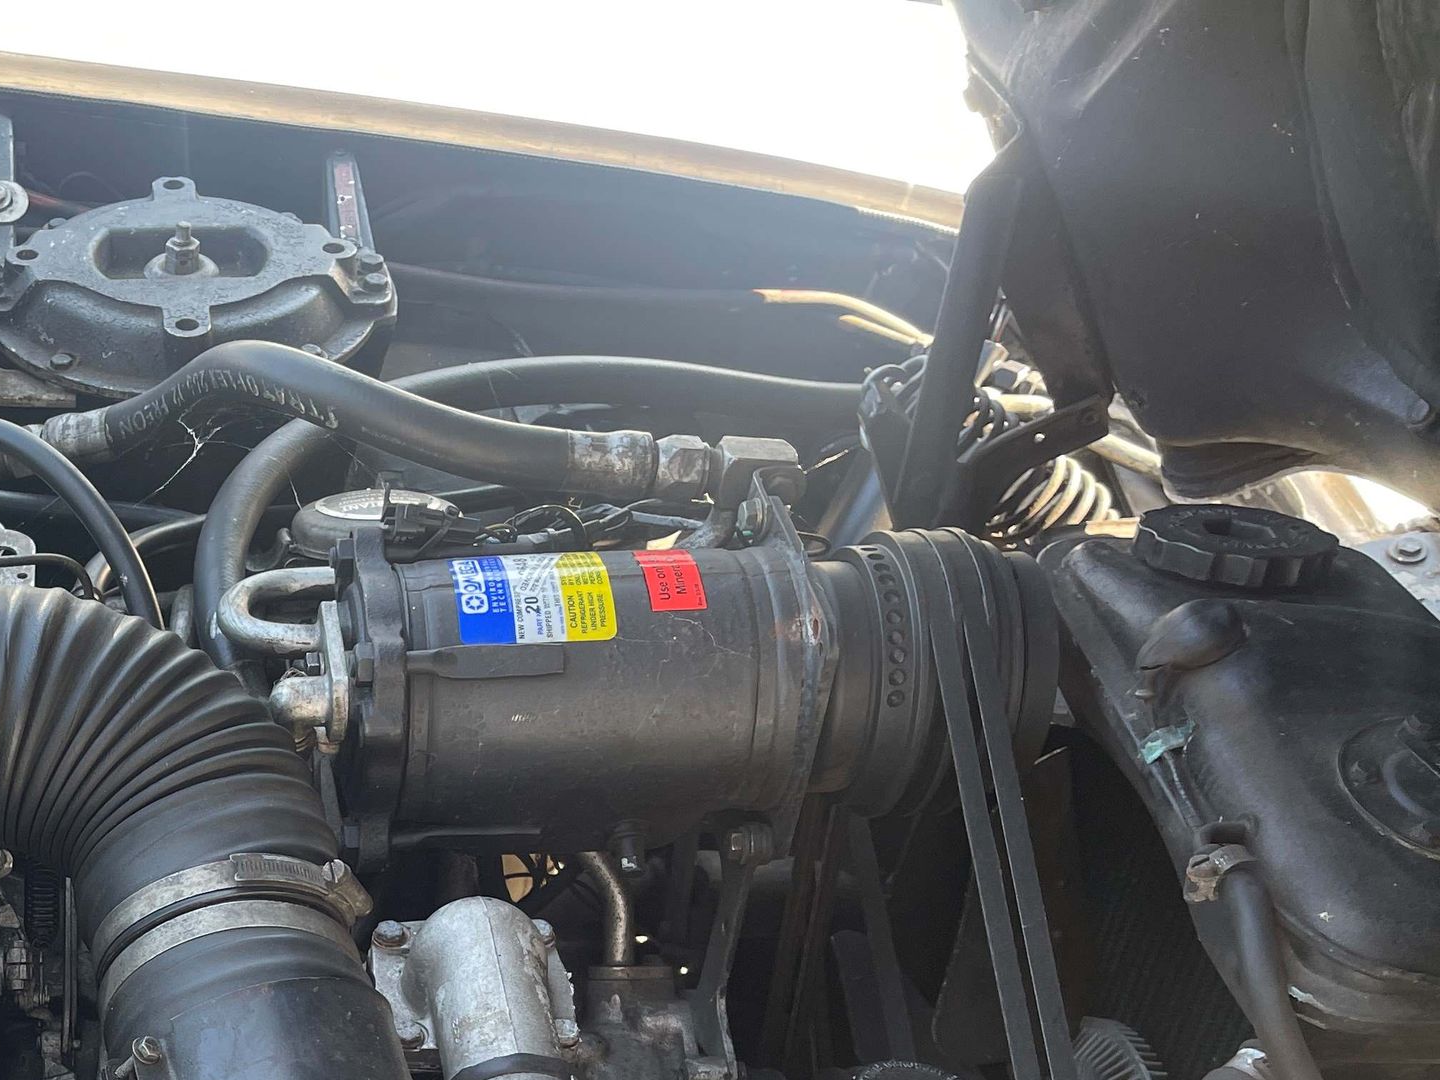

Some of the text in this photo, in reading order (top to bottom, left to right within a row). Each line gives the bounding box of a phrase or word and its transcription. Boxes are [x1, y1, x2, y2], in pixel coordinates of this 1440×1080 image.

[118, 393, 170, 439] FREON
[659, 582, 671, 600] Use
[672, 564, 687, 595] Minera
[544, 610, 554, 638] SHIPPED
[567, 595, 578, 628] CAUTION
[576, 590, 587, 634] REFRIGERANT
[587, 592, 597, 631] UNDER HIGH
[597, 594, 606, 628] PRESSURE
[518, 627, 526, 639] NEW
